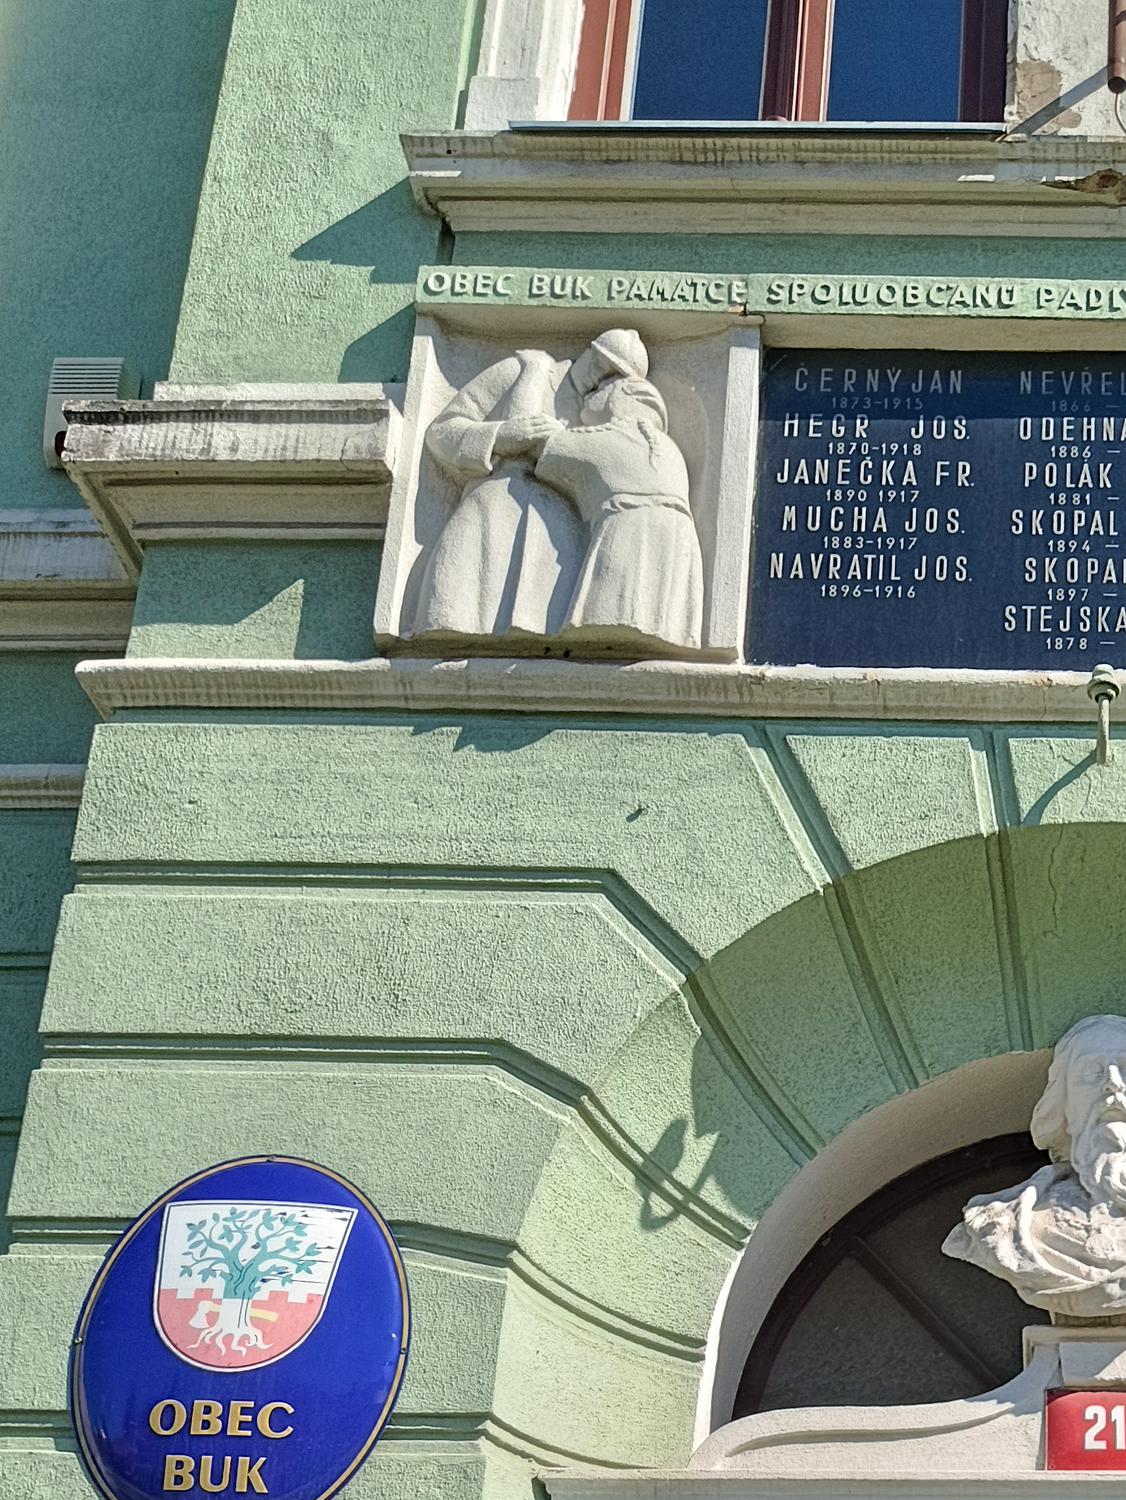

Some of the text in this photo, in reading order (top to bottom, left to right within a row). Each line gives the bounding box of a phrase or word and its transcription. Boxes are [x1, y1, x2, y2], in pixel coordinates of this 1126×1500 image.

[424, 271, 515, 297] OBEC
[529, 273, 594, 299] BUK
[795, 363, 962, 394] ČERNÝ JAN
[831, 397, 923, 410] 1873-1915
[783, 412, 970, 440] HEGR JOS.
[828, 441, 922, 456] 1870-1918
[1051, 446, 1091, 459] 1886
[776, 456, 975, 487] JANEČKA FR.
[1024, 458, 1113, 489] POLÁK
[826, 489, 920, 503] 1890 1917
[1049, 493, 1091, 505] 1881
[782, 505, 965, 534] MUCHA JOS.
[1011, 509, 1119, 536] SKOPAL
[823, 536, 917, 550] 1883-1917
[1048, 540, 1091, 553] 1894
[770, 553, 973, 582] NAVRATIL JOS.
[821, 584, 916, 599] 1896-1916
[1048, 588, 1089, 601] 1897
[1046, 637, 1089, 650] 1878
[148, 1398, 295, 1439] OBEC
[1084, 1404, 1126, 1451] 21
[162, 1454, 269, 1495] BUK
